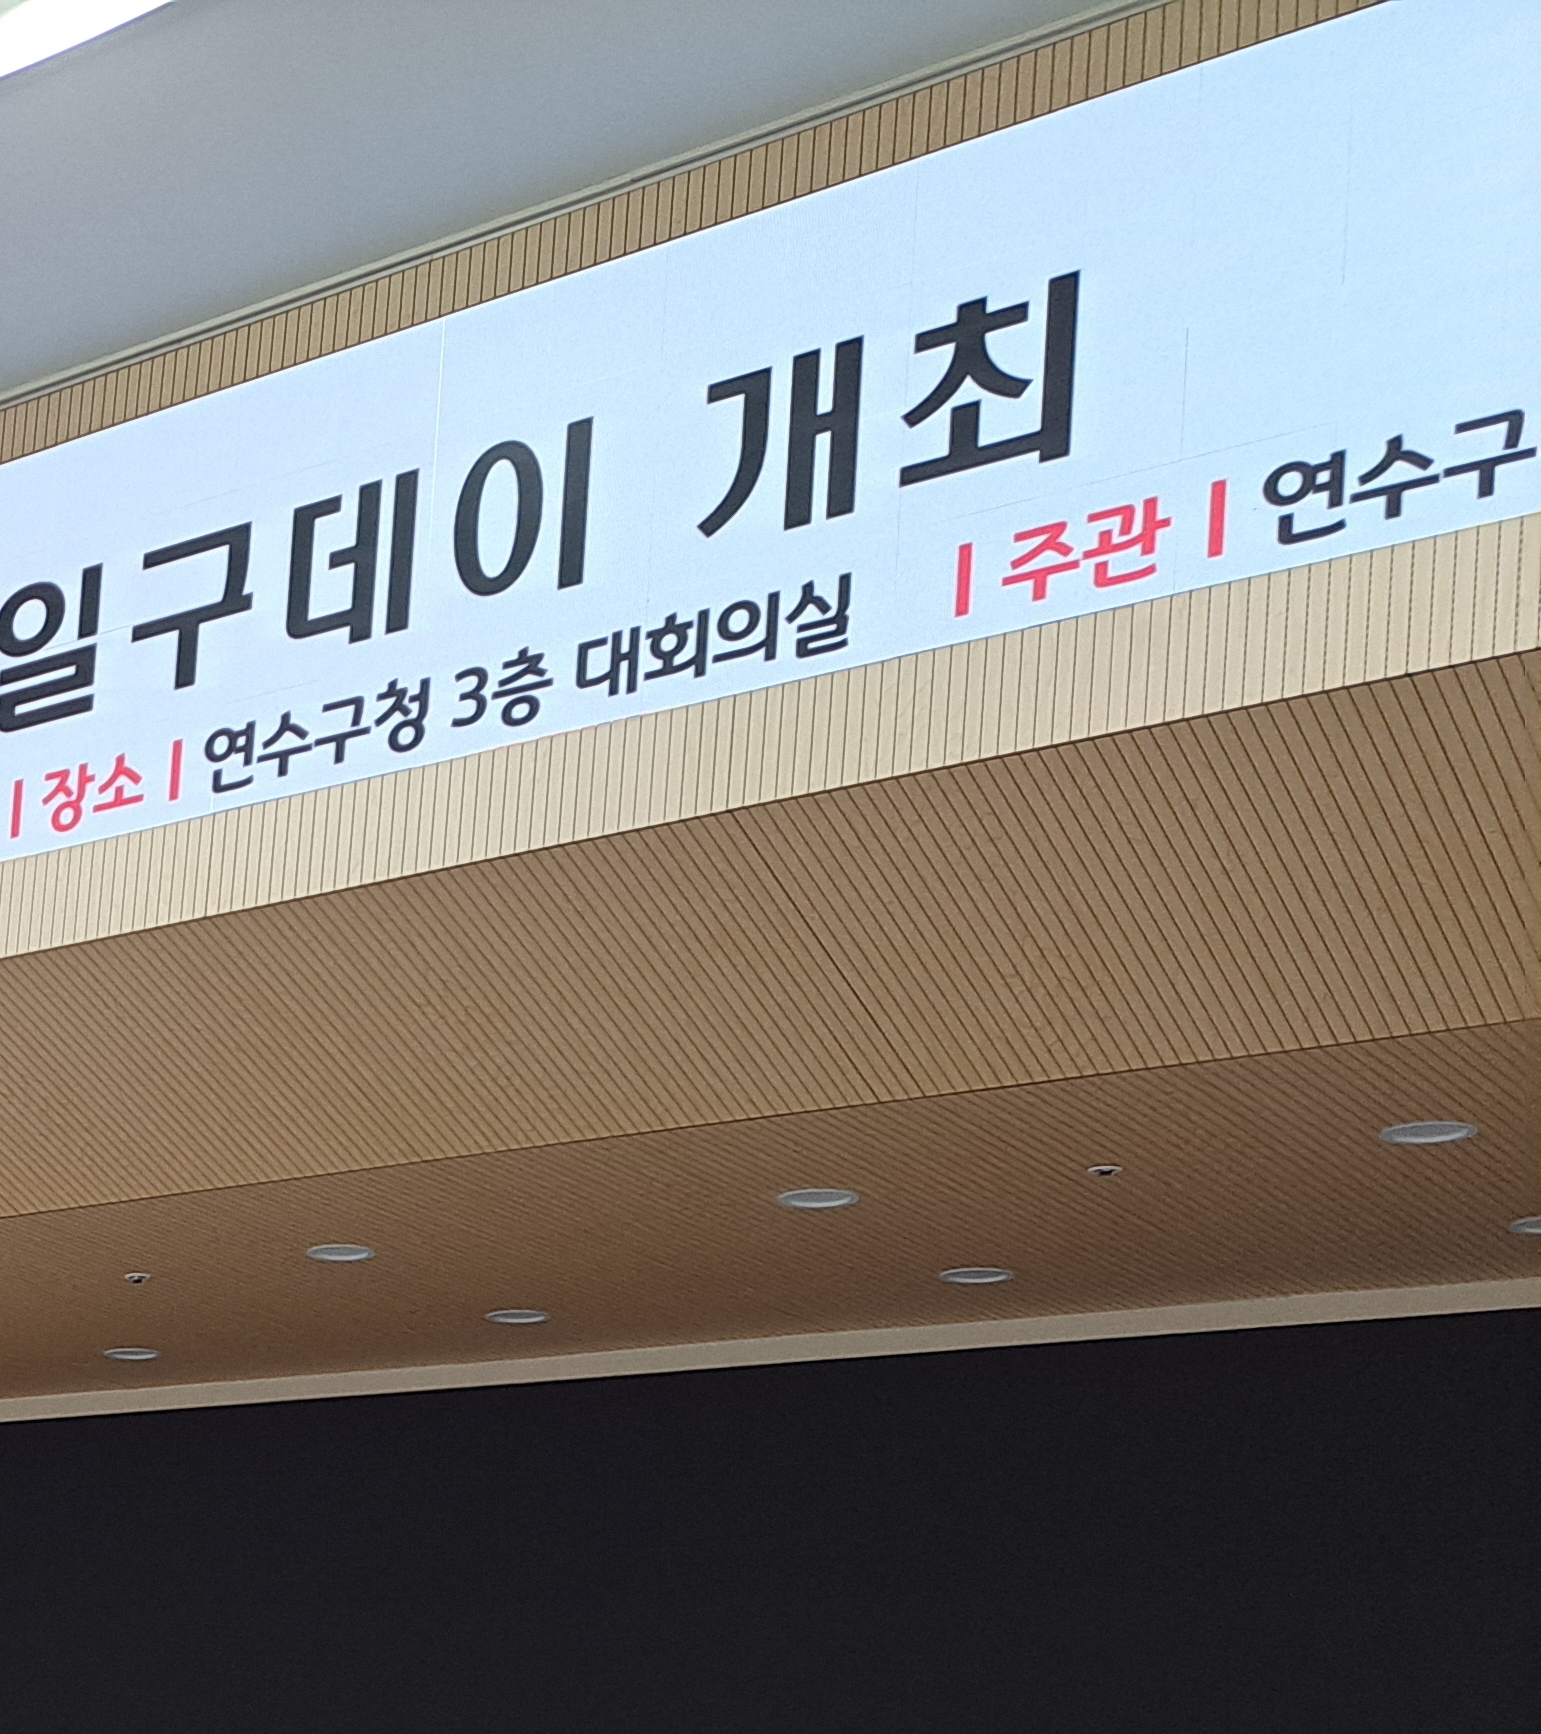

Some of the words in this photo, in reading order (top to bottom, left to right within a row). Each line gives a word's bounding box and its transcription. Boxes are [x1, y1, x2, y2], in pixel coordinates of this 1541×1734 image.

[696, 269, 1081, 539] 개최
[1001, 495, 1172, 603] 주관
[1262, 408, 1538, 546] 연수구
[42, 752, 145, 834] 장소
[204, 677, 432, 794] 연수구청
[450, 646, 554, 729] 3층
[575, 571, 853, 697] 대회의실
